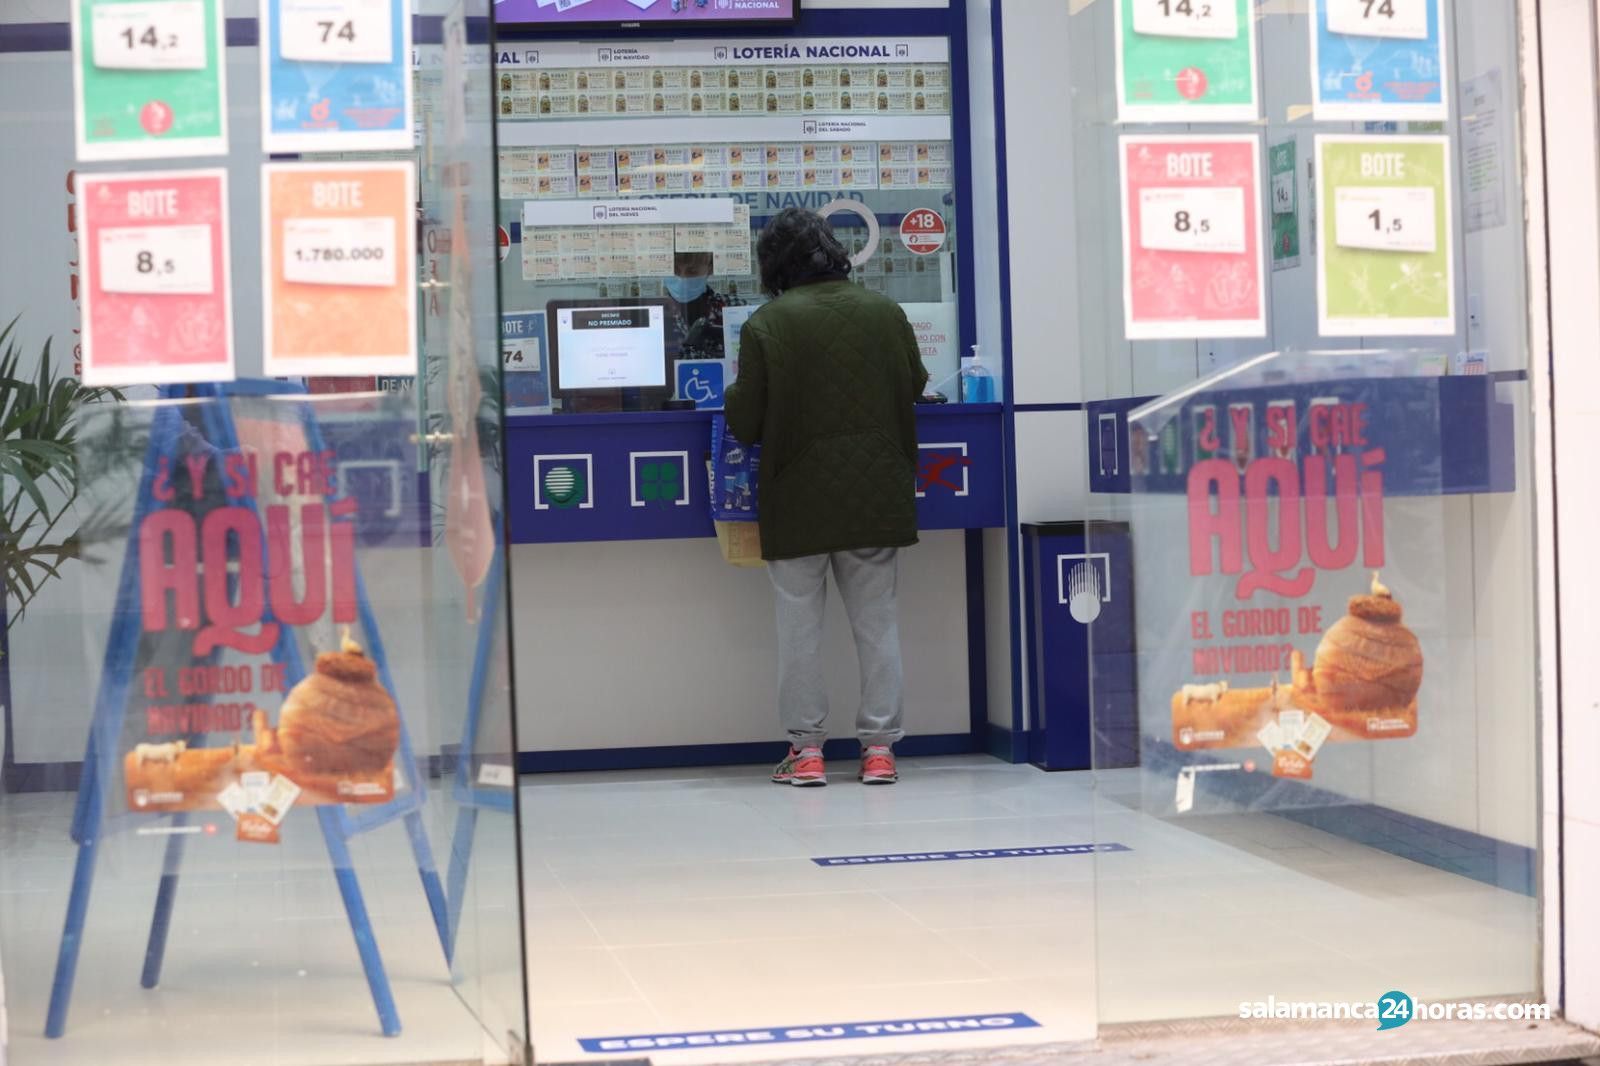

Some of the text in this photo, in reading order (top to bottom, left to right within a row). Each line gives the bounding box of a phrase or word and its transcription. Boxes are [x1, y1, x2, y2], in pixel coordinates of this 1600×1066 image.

[734, 1, 780, 9] NACIONAL
[1359, 0, 1395, 19] 74
[317, 20, 355, 42] 74
[733, 44, 890, 59] LOTERÍA NACIONAL
[1166, 152, 1214, 178] BOTE
[1360, 152, 1406, 178] BOTE
[127, 189, 178, 218] BOTE
[312, 181, 364, 209] BOTE
[910, 213, 935, 228] +18
[294, 246, 385, 262] 1.780.000
[502, 321, 523, 334] OTE
[503, 349, 524, 363] 74
[1266, 406, 1296, 447] SI
[1309, 403, 1368, 447] CAE
[224, 452, 259, 498] SI
[273, 450, 337, 497] CAE
[1187, 448, 1386, 600] AQUÍ
[139, 496, 359, 656] AQUÍ
[1190, 606, 1322, 640] EL GORDO DE
[1192, 644, 1293, 675] NAVIDAD?
[143, 663, 288, 698] EL GORDO DE
[147, 703, 257, 735] NAVIDAD?
[828, 854, 949, 864] ESPERE
[1003, 845, 1113, 855] TURNO
[599, 1016, 1015, 1050] ESPERE SU TURNO
